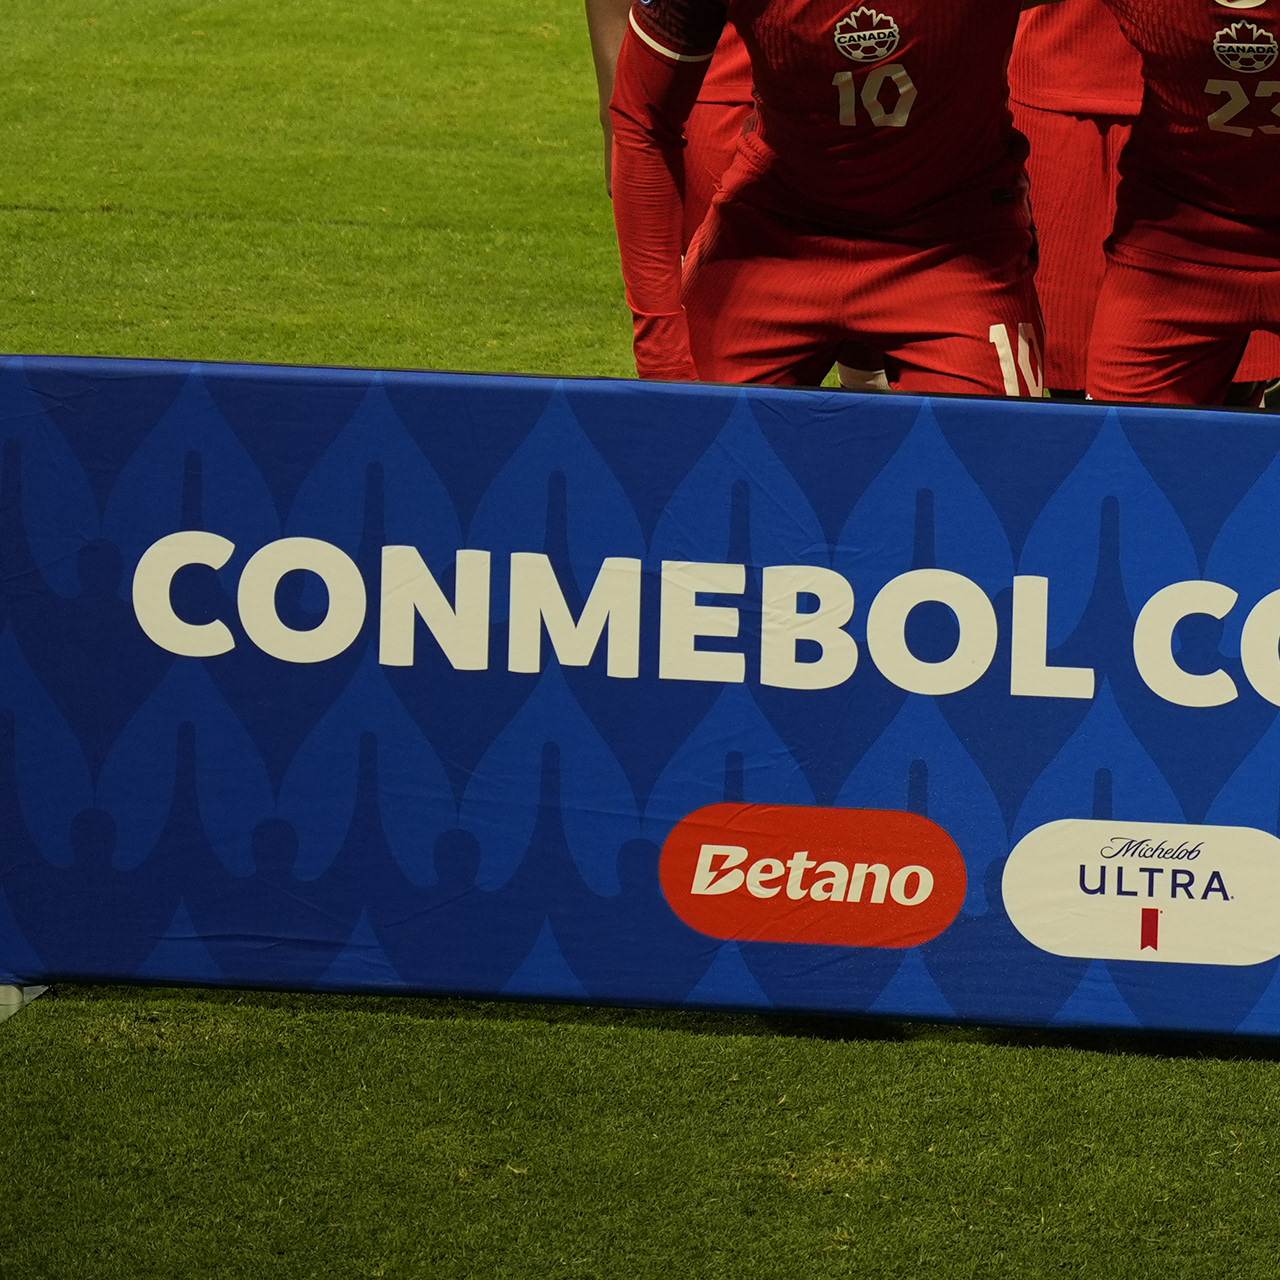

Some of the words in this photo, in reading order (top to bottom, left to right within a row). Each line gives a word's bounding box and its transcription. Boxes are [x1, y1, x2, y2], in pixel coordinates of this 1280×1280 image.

[836, 30, 897, 45] CANADA
[1215, 44, 1276, 55] CANADA
[831, 63, 918, 128] 10
[989, 322, 1045, 398] 10
[132, 531, 1095, 699] CONMEBOL
[1099, 836, 1203, 861] Michelob
[691, 844, 934, 906] Betano
[1079, 864, 1230, 901] ULTRA
